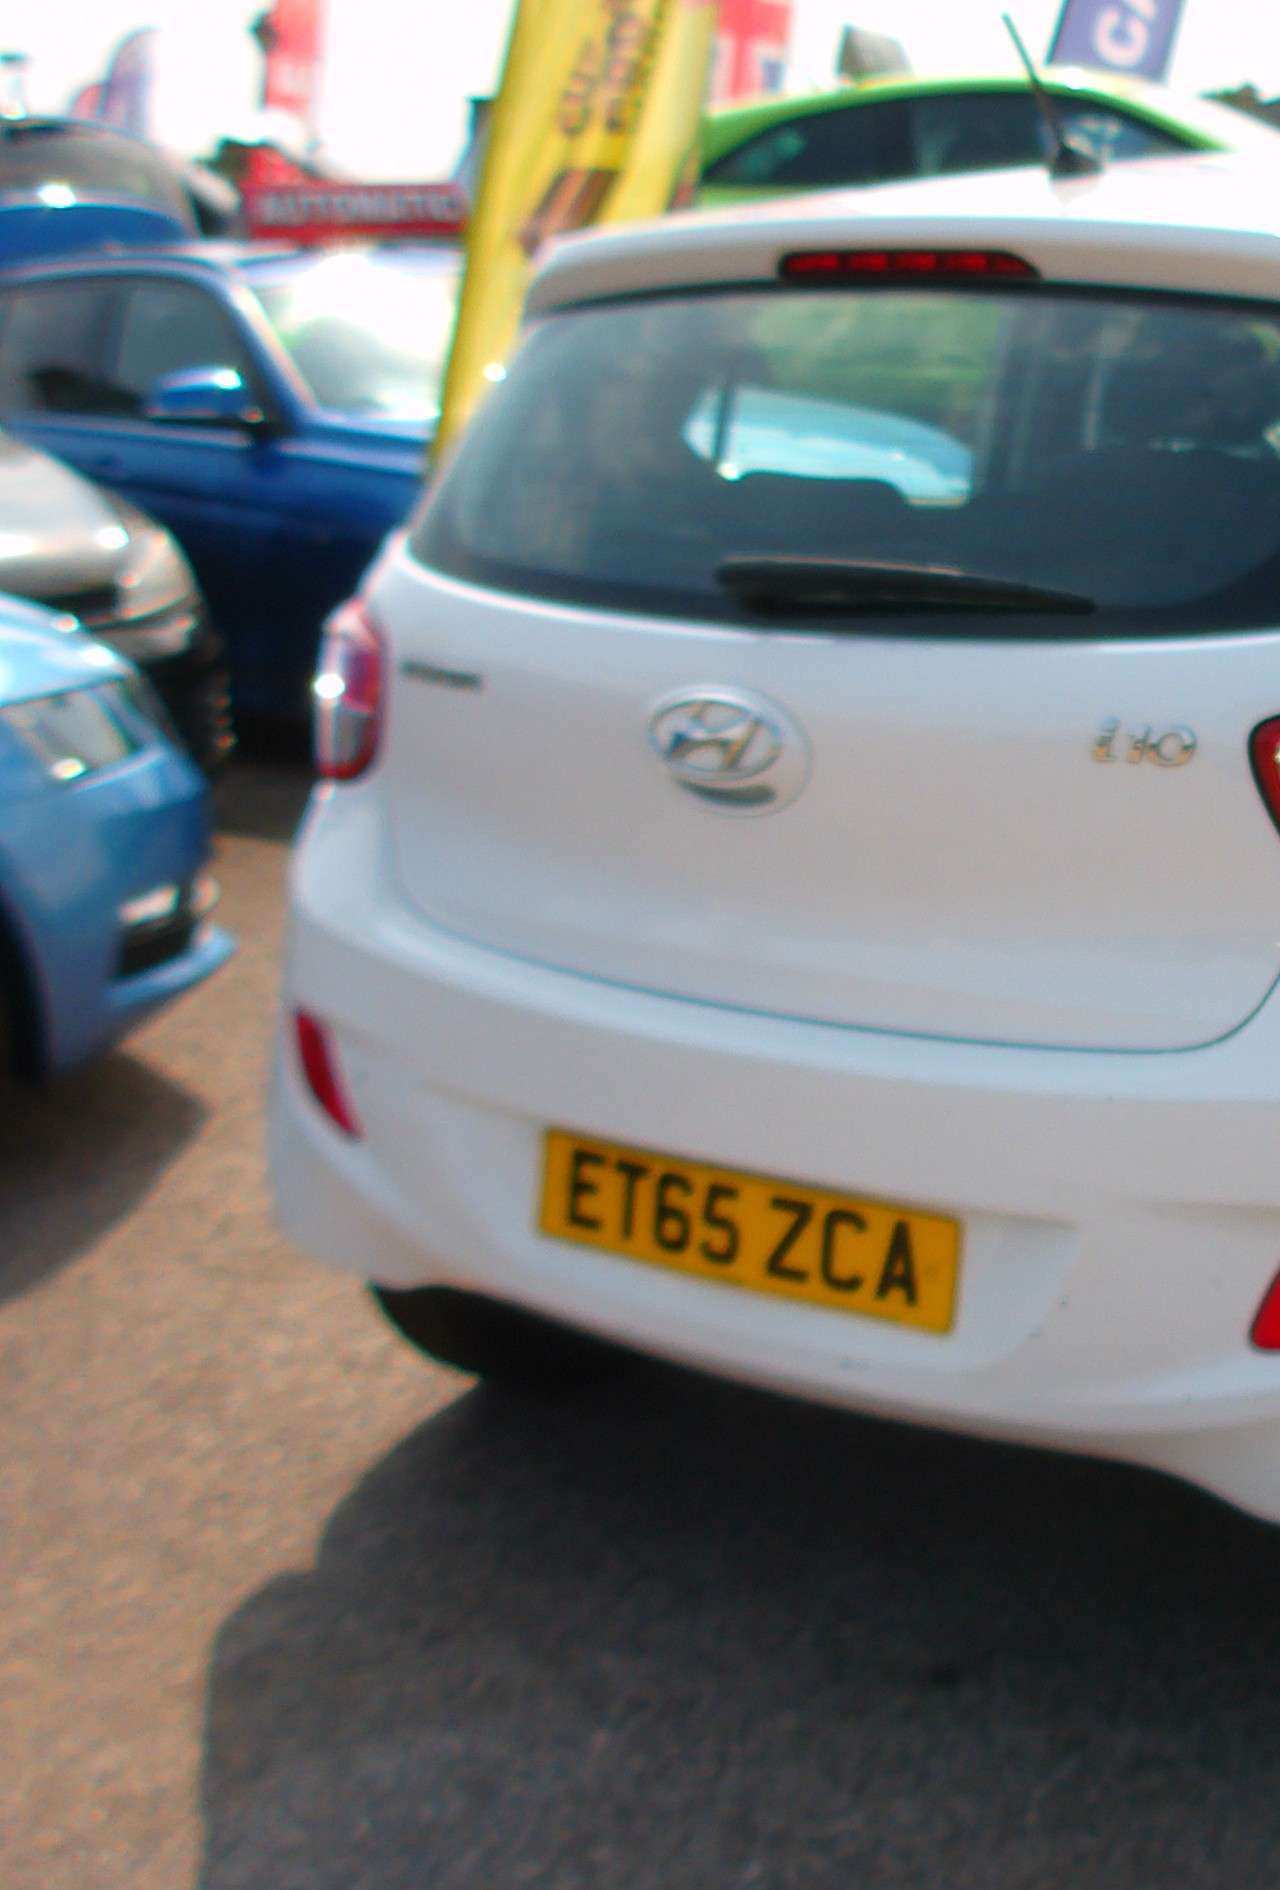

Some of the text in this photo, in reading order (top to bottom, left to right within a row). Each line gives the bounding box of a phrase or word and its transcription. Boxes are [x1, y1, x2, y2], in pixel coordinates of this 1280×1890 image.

[1091, 714, 1199, 768] i10
[567, 1149, 918, 1308] ET65 ZCA
